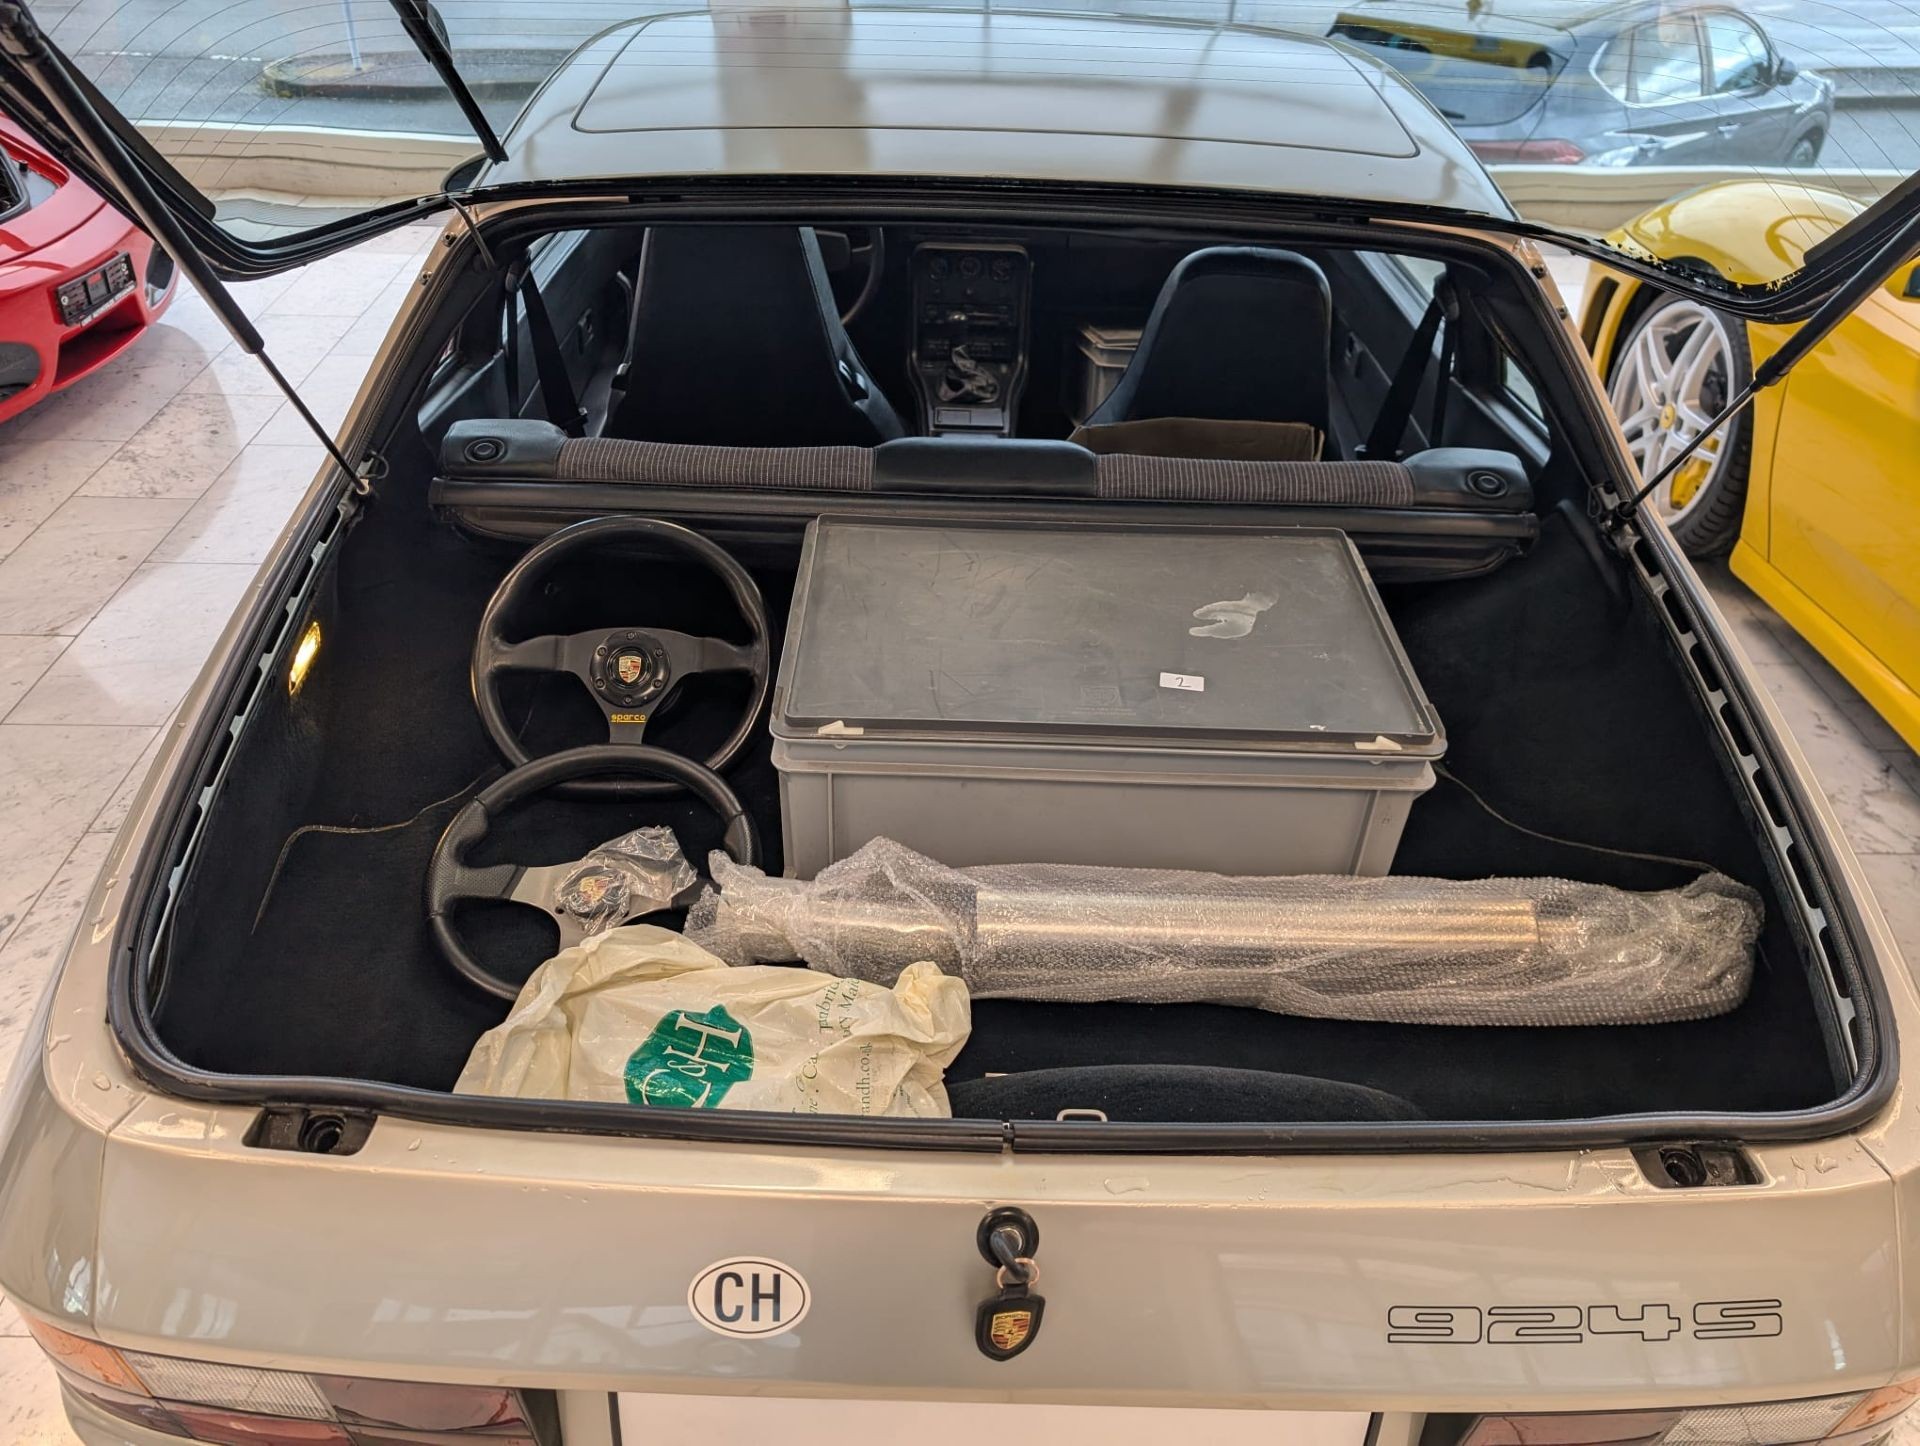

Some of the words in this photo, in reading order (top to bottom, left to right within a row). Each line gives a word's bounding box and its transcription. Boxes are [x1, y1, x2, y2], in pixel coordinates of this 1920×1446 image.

[1175, 676, 1192, 687] 2
[611, 714, 646, 723] sparco
[714, 1271, 781, 1323] CH
